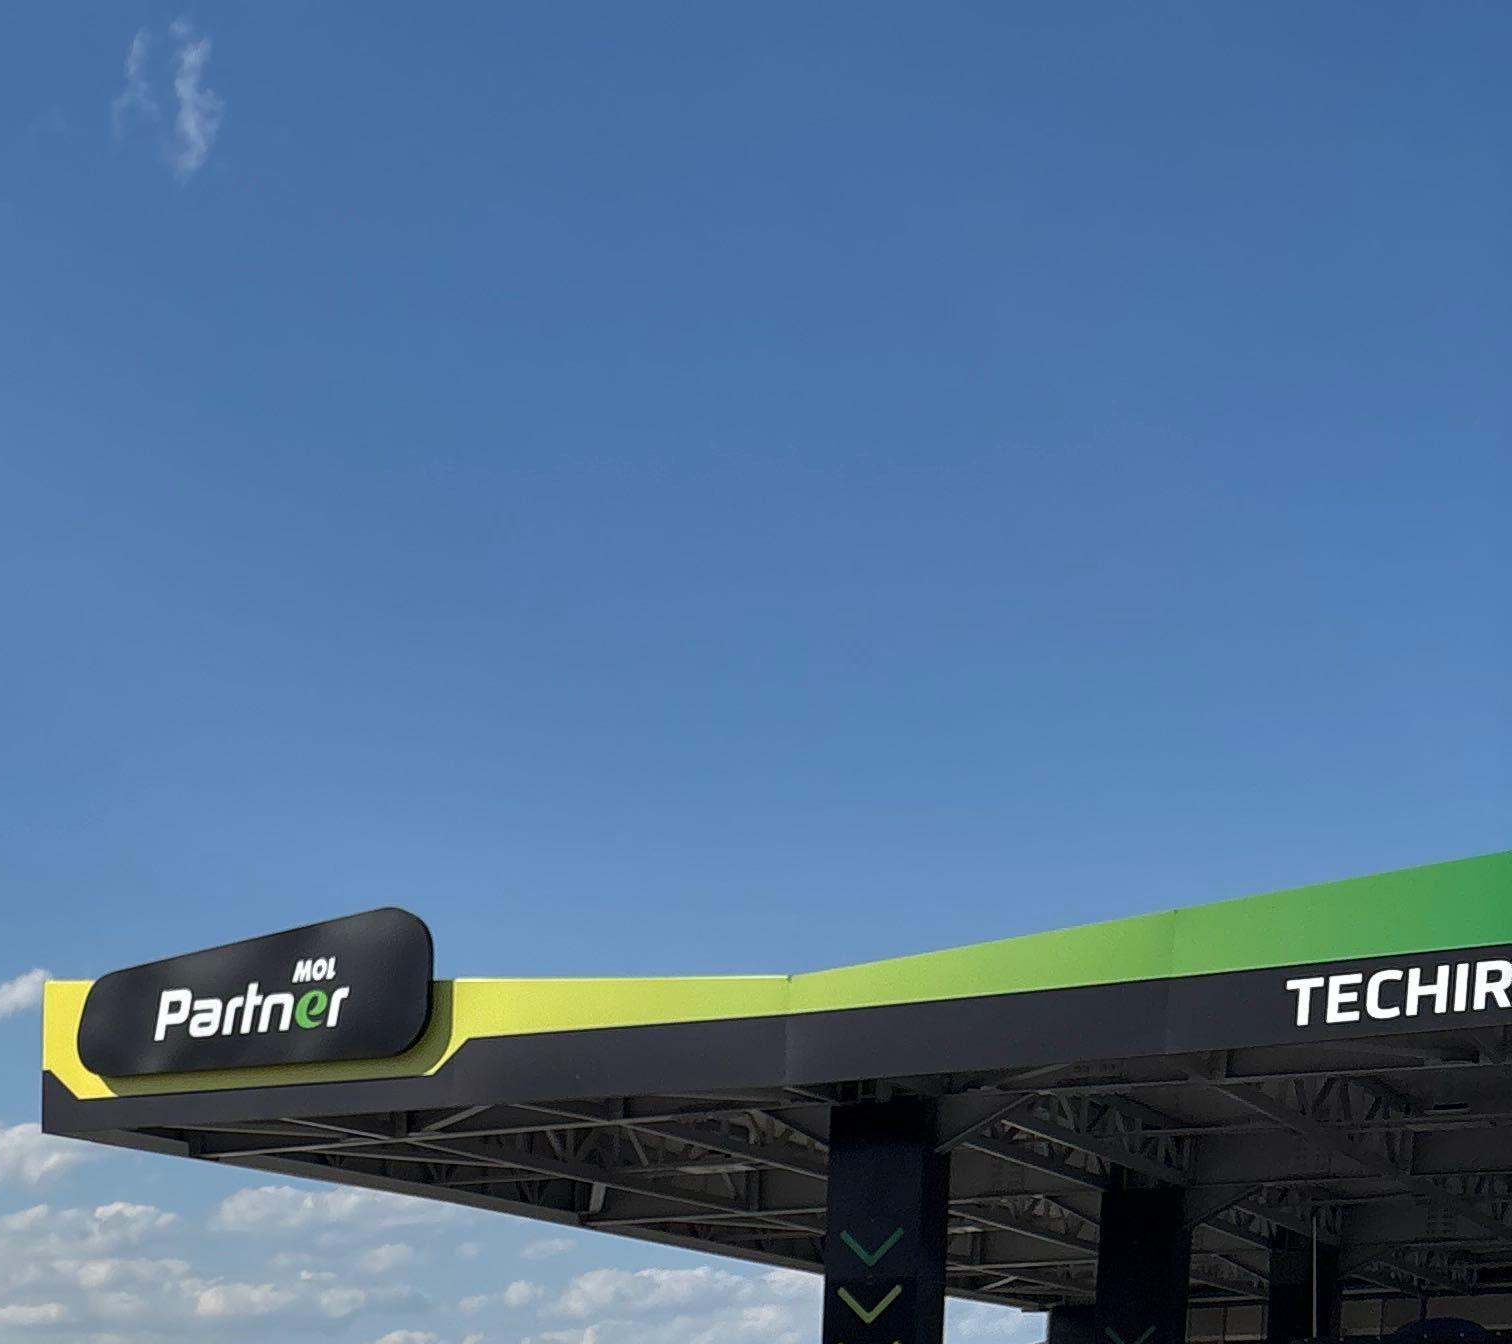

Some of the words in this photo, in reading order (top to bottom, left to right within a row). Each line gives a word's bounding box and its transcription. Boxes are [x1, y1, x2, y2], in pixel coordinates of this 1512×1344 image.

[291, 955, 337, 984] MOL
[1286, 959, 1512, 1027] TECHIR
[153, 981, 351, 1042] Partner
